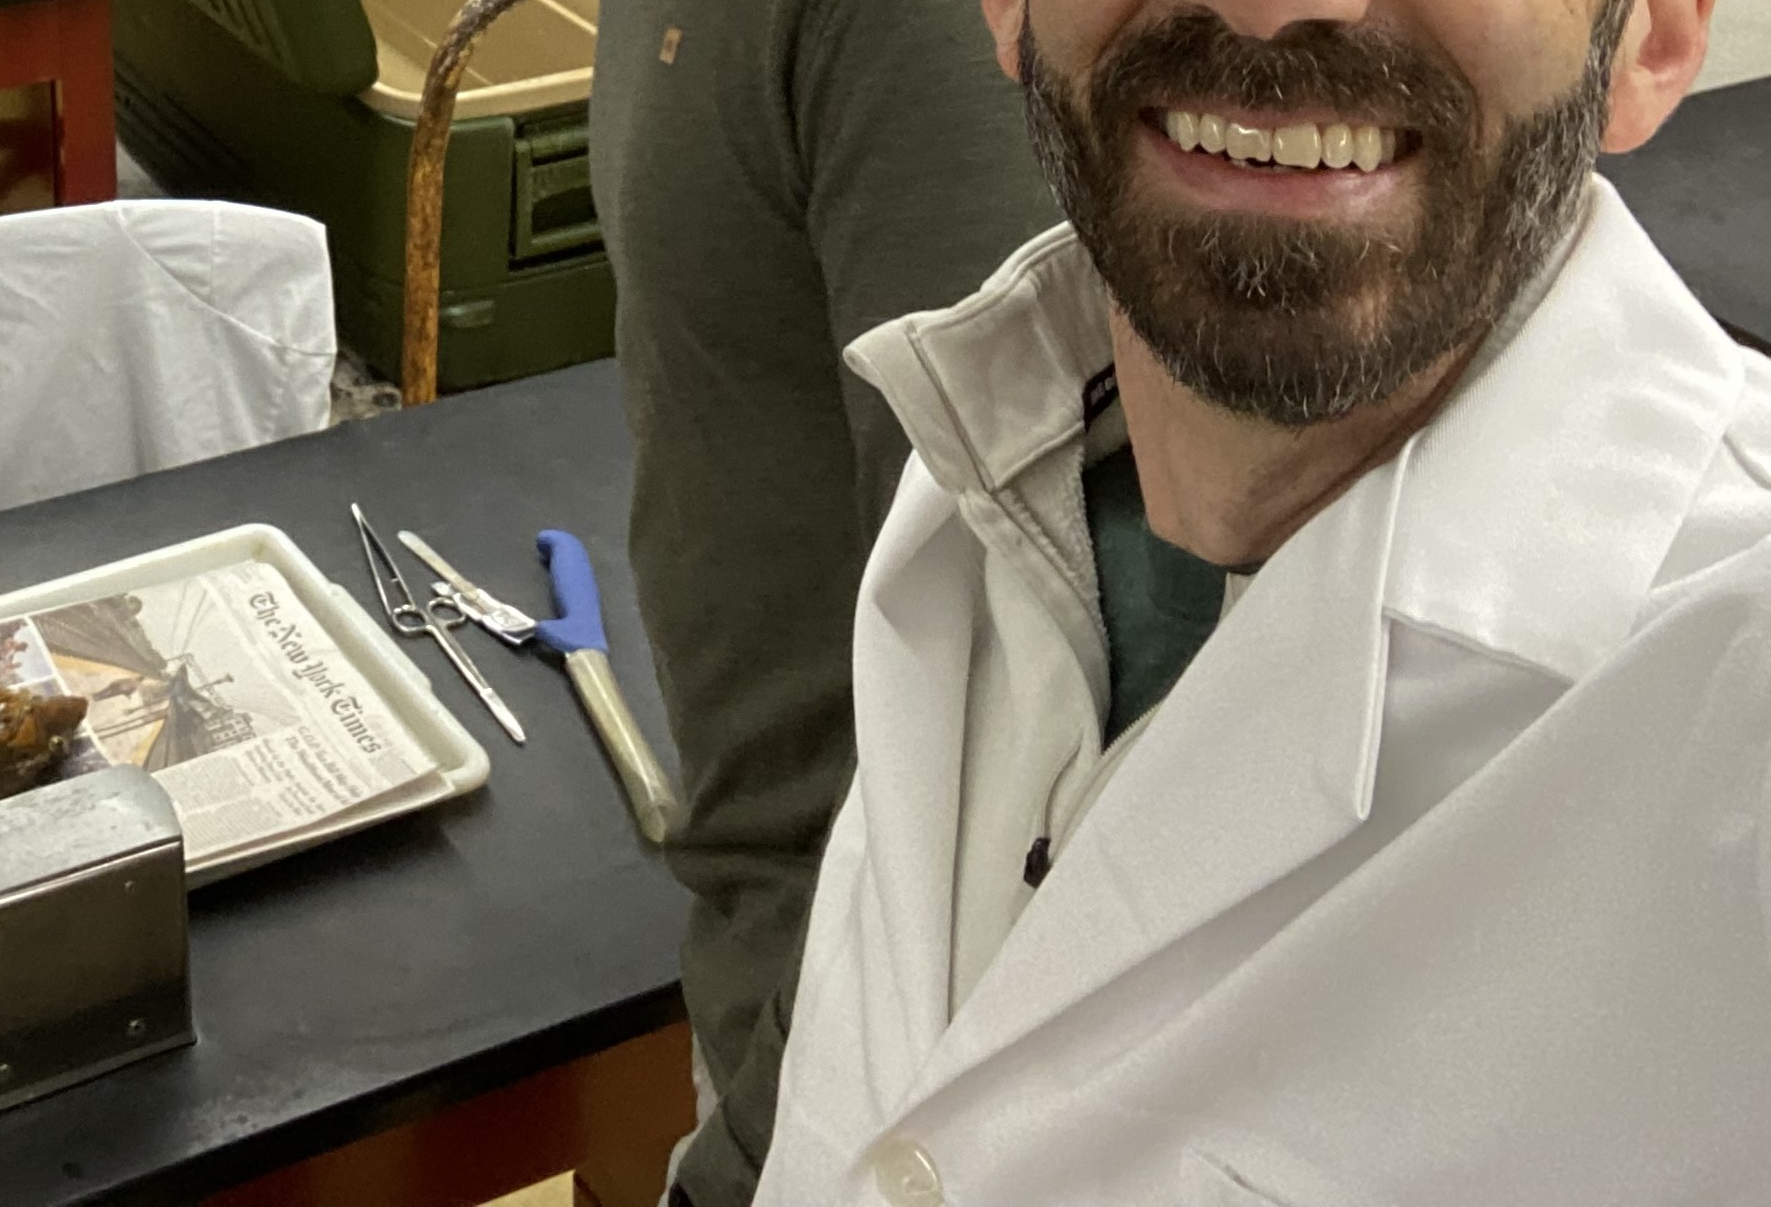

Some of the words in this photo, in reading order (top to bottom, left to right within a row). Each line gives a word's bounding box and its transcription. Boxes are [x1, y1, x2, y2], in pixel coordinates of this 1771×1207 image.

[249, 591, 281, 626] The
[268, 624, 309, 664] New
[292, 661, 345, 699] York
[330, 696, 382, 753] Times
